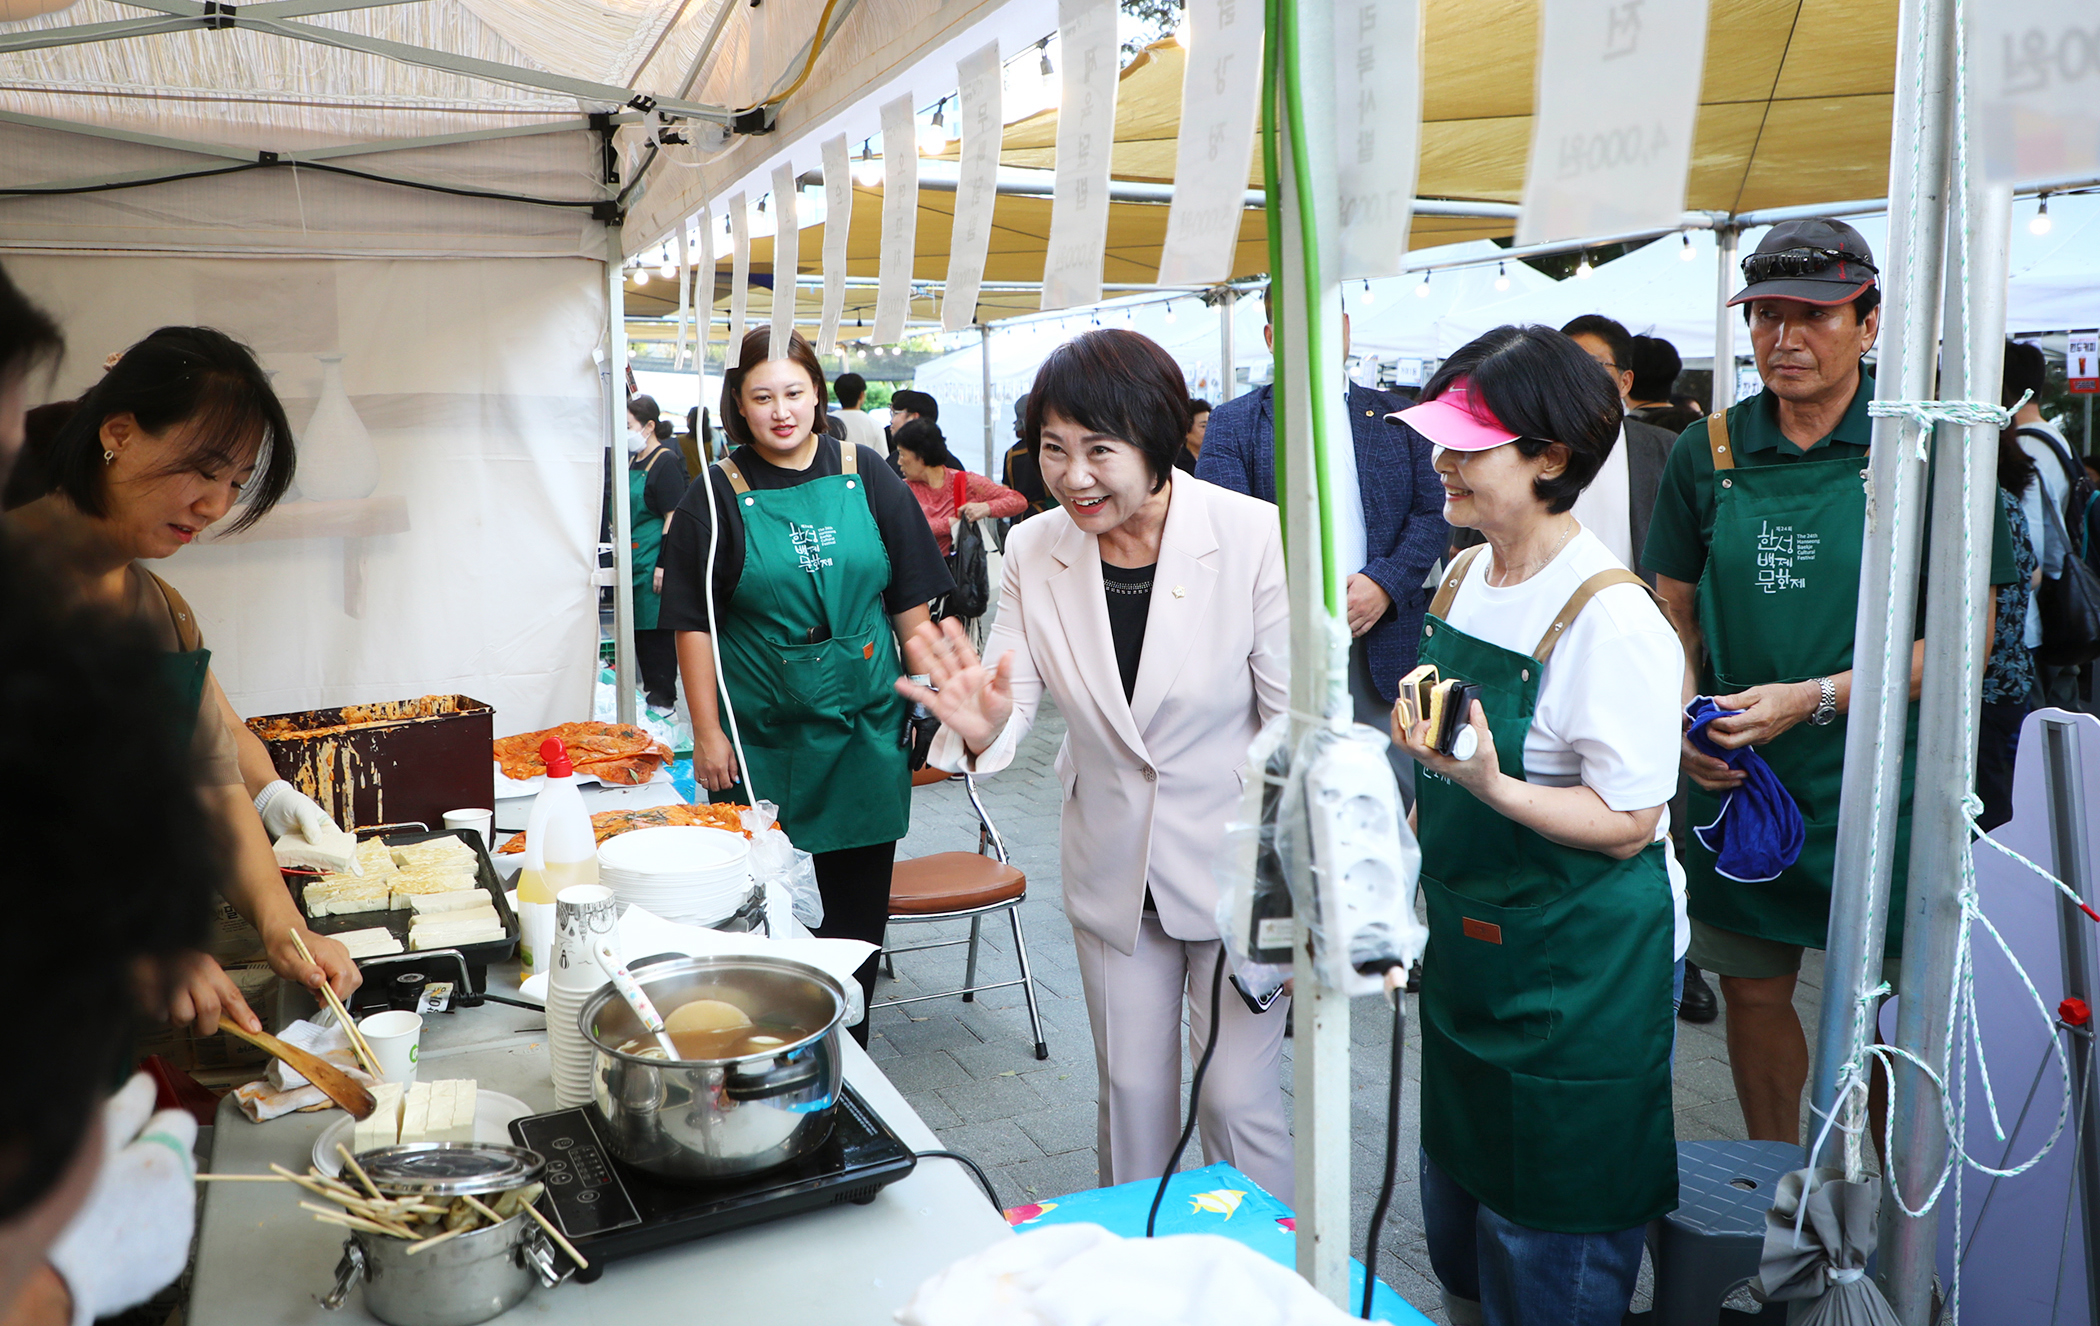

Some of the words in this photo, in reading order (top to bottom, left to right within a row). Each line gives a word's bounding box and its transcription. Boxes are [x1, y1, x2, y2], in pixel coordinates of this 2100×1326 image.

[1757, 520, 1794, 554] 한성
[1757, 552, 1793, 569] 백제
[1754, 568, 1806, 594] 문화제
